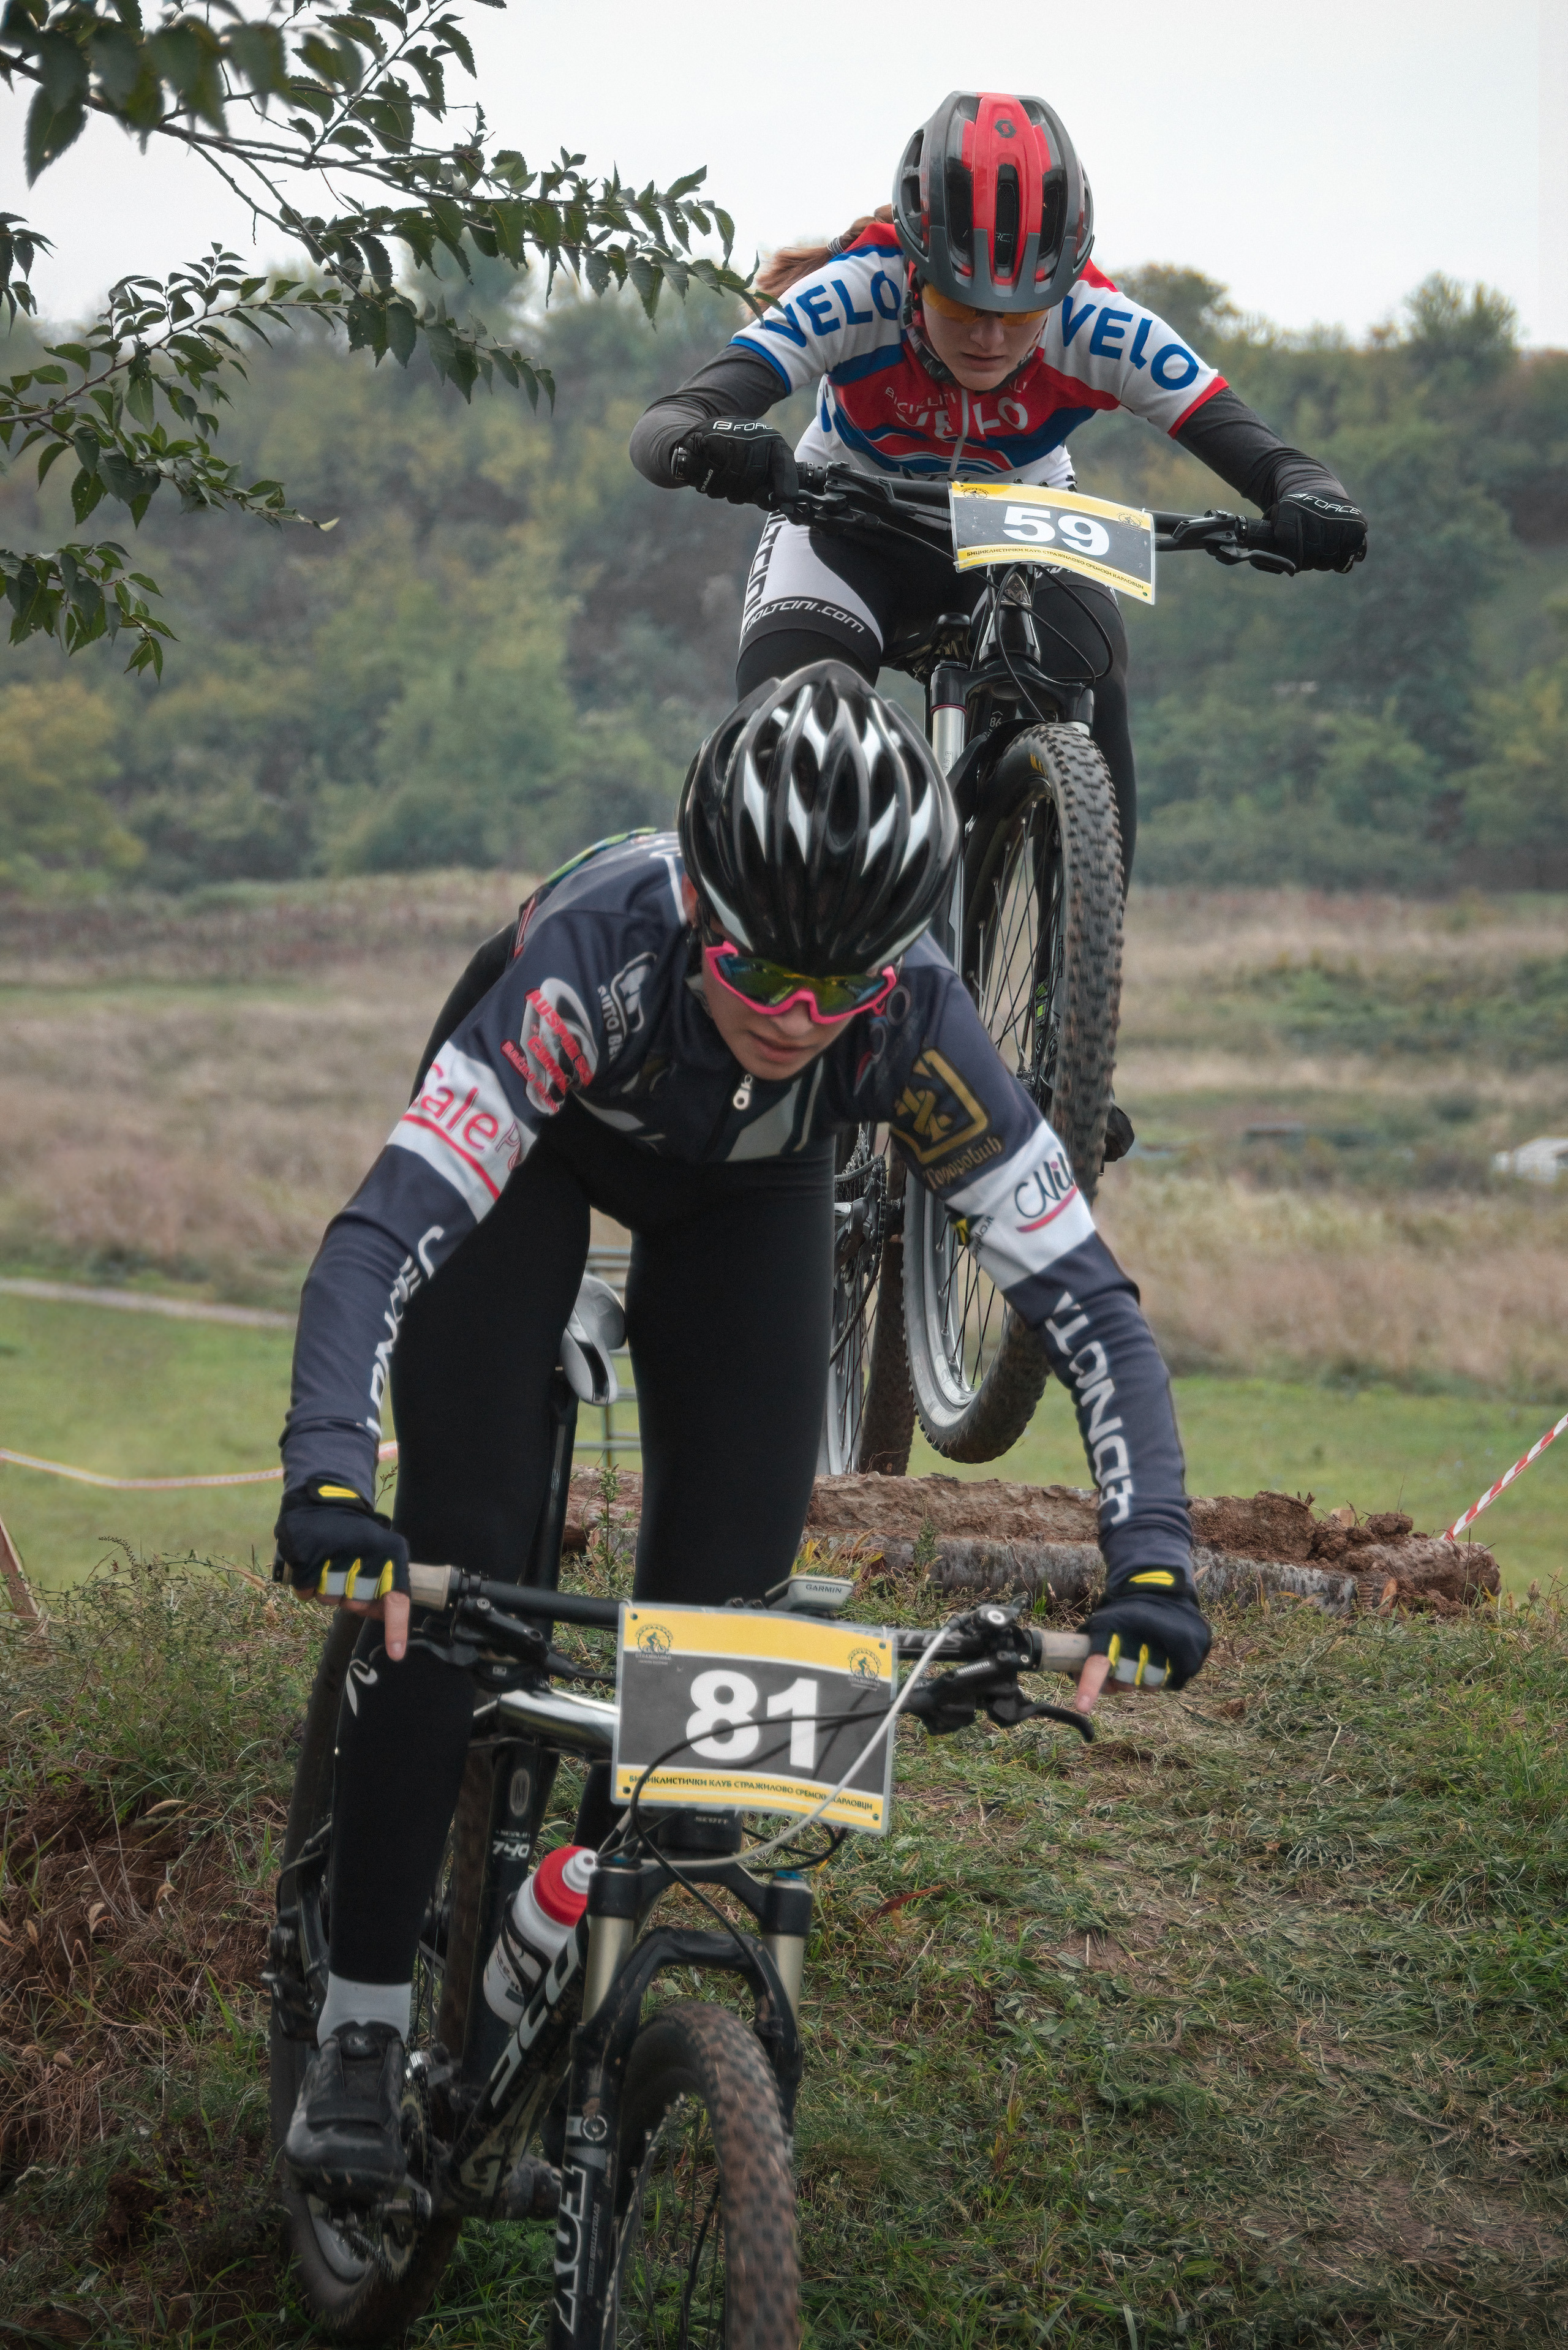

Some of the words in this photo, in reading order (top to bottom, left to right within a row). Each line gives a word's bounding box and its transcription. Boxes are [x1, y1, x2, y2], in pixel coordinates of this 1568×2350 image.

[766, 270, 901, 348] VELO
[1061, 295, 1199, 391] VELO
[895, 397, 1028, 439] VELO
[1002, 506, 1110, 556] 59
[805, 1584, 842, 1594] GARMIN
[686, 1670, 818, 1769] 81
[629, 1775, 707, 1787] БИКЛИСТИЧКИ
[734, 1780, 794, 1794] СТРАЖИЛОВО
